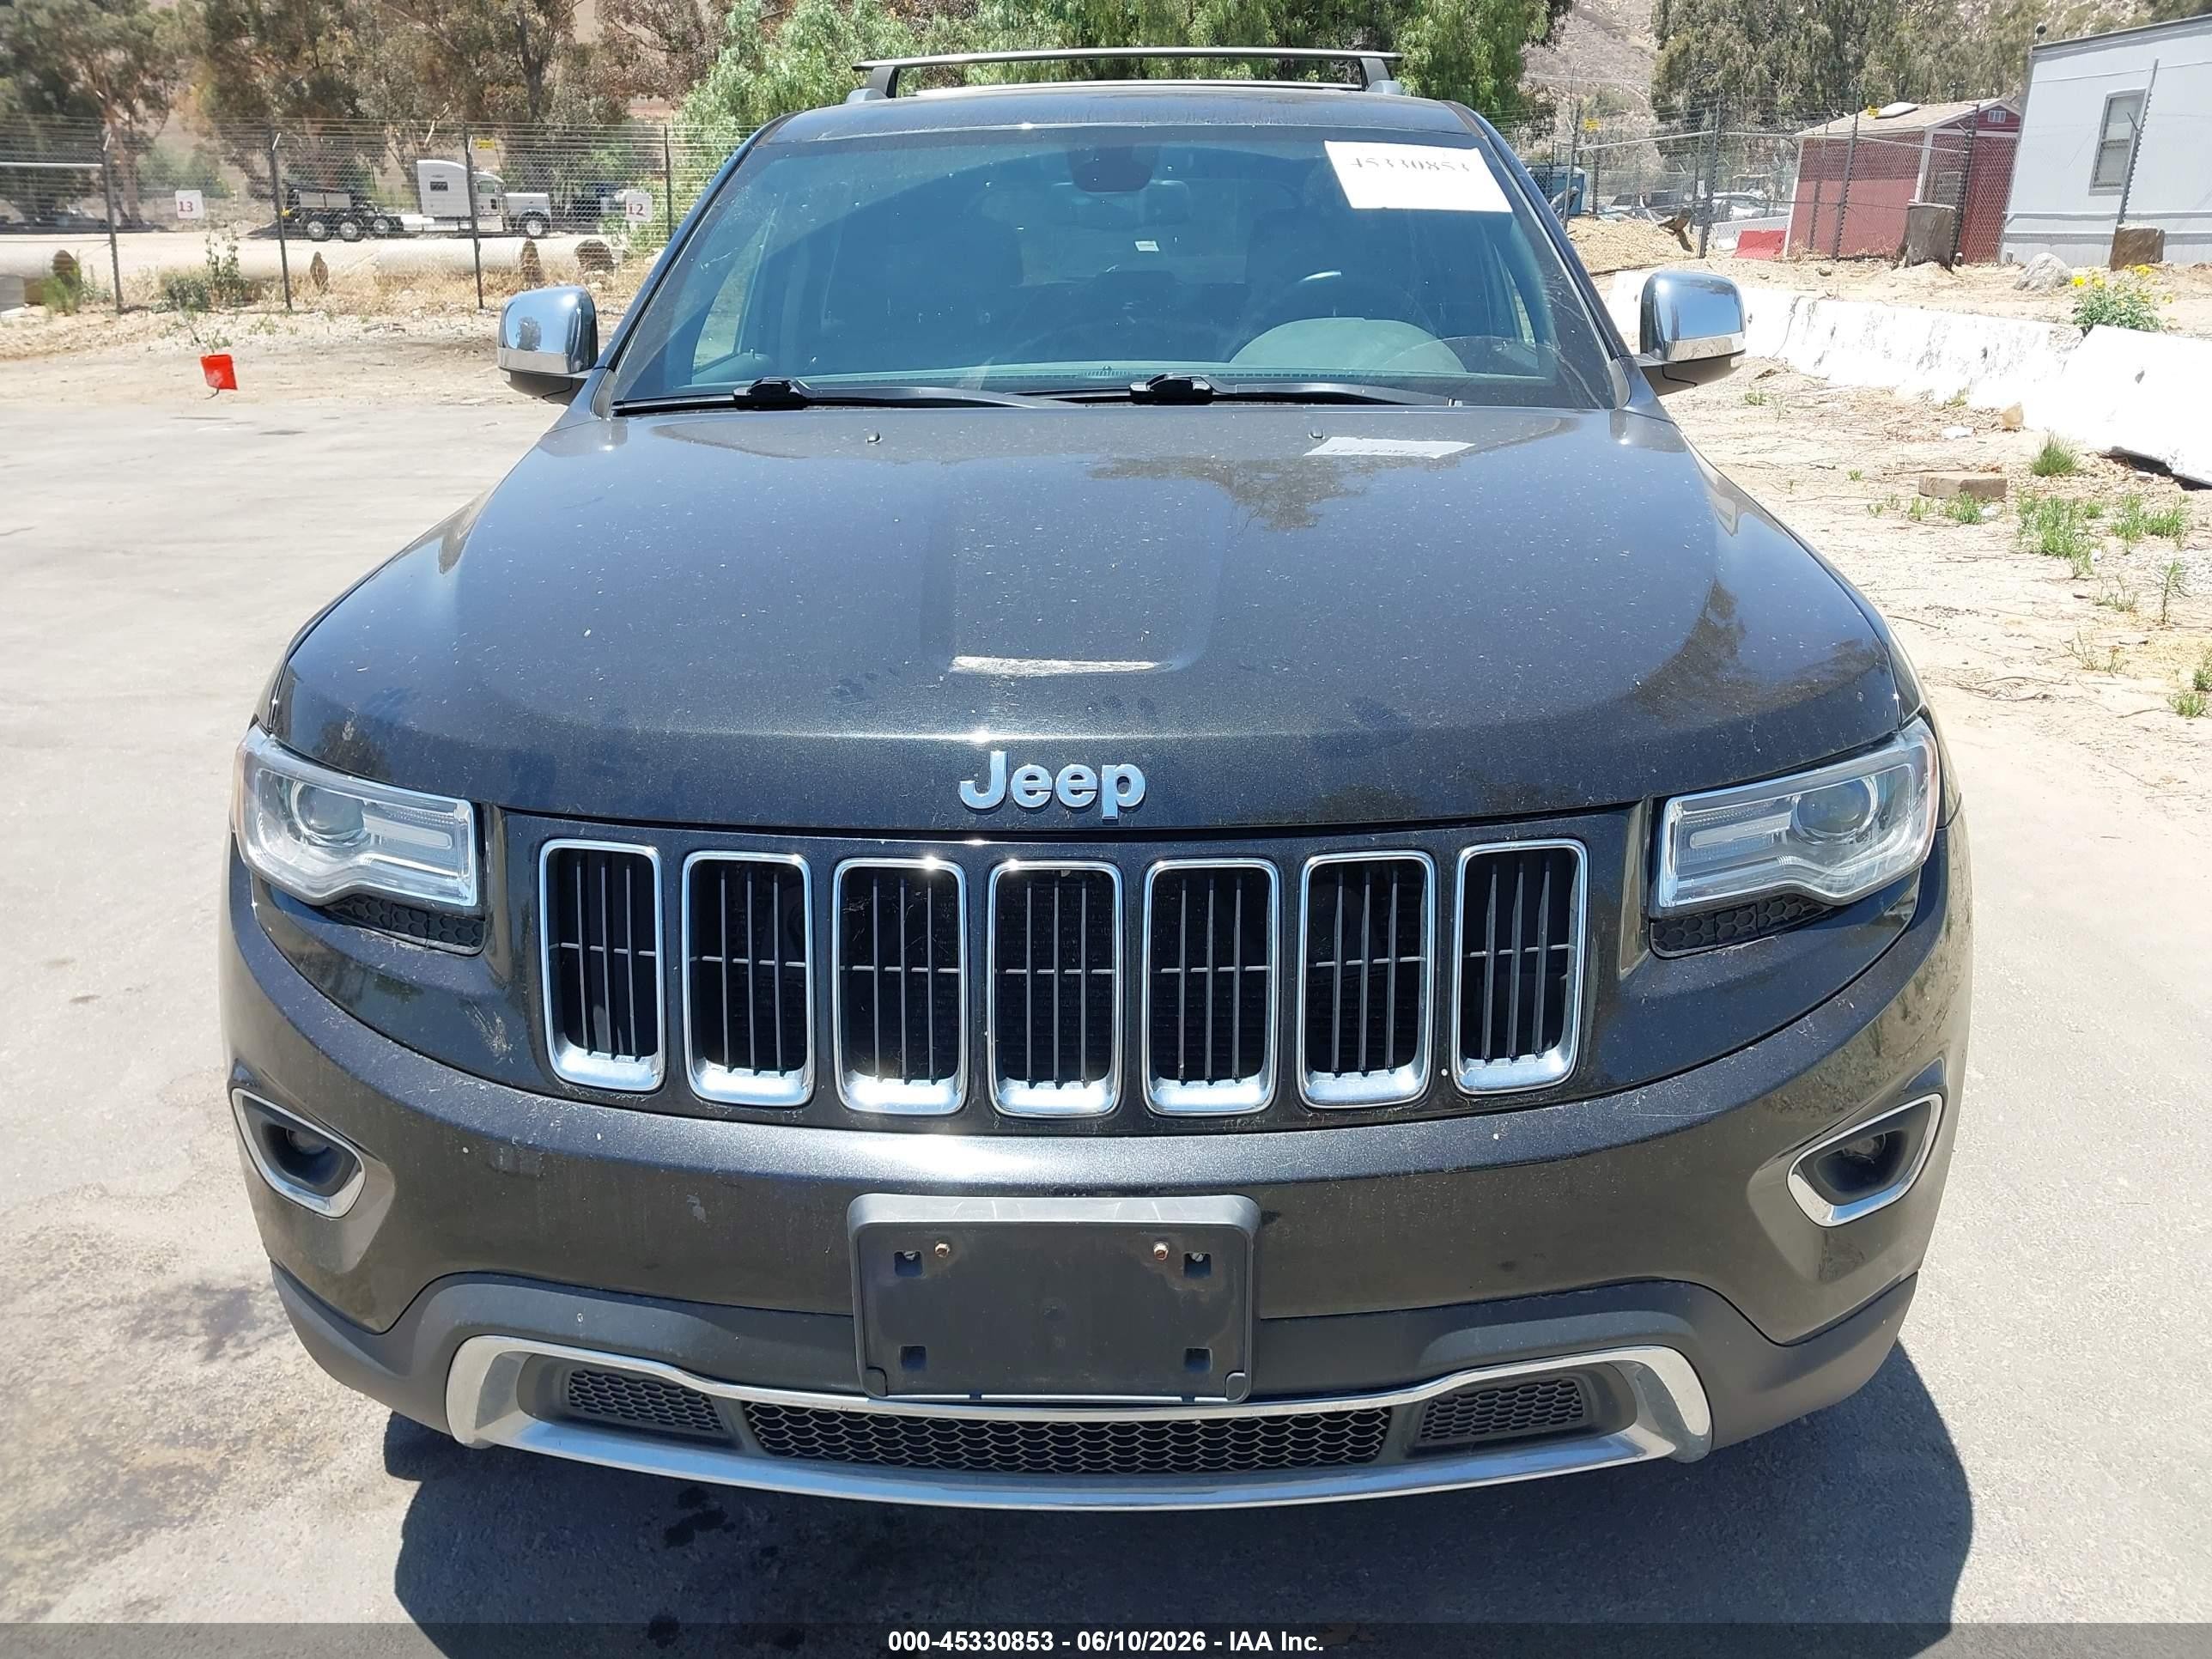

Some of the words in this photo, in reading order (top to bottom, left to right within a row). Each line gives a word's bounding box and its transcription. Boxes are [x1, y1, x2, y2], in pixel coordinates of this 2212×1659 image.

[178, 201, 193, 212] 13
[628, 203, 647, 217] 12
[959, 750, 1146, 820] Jeep
